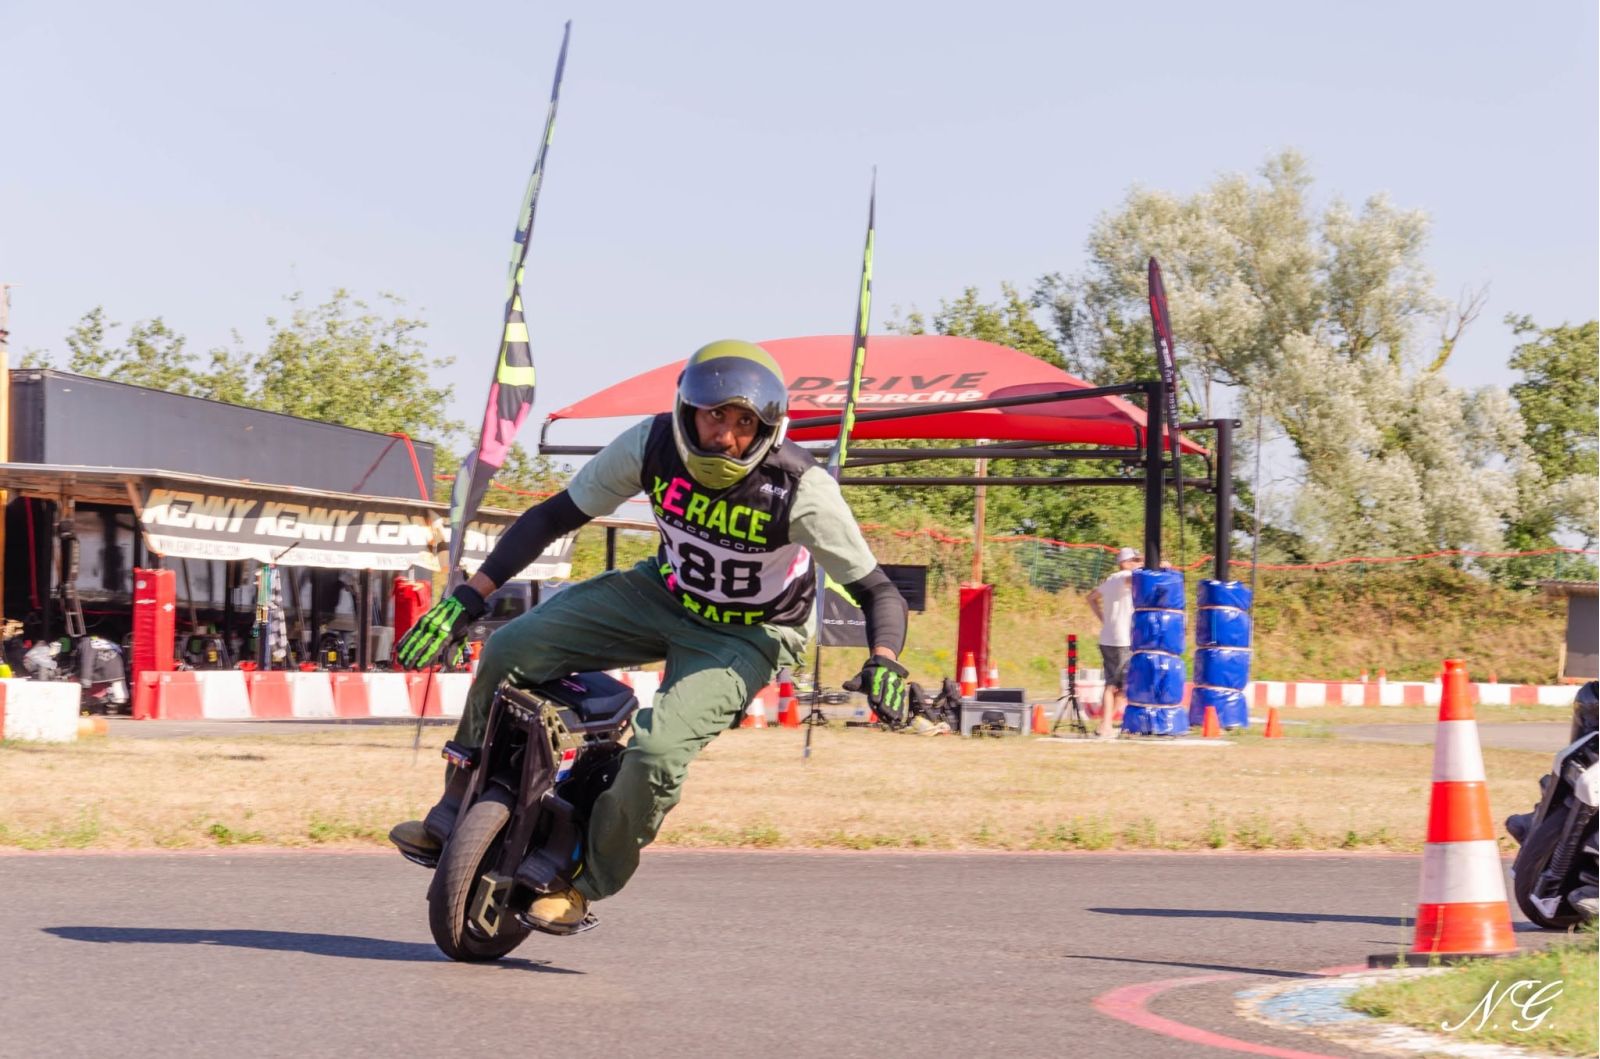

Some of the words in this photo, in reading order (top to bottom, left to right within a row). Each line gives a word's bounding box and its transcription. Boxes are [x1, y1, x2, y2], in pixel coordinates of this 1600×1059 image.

[788, 372, 989, 391] DRIVE
[141, 489, 257, 533] KENNY
[254, 501, 359, 542] KENNY
